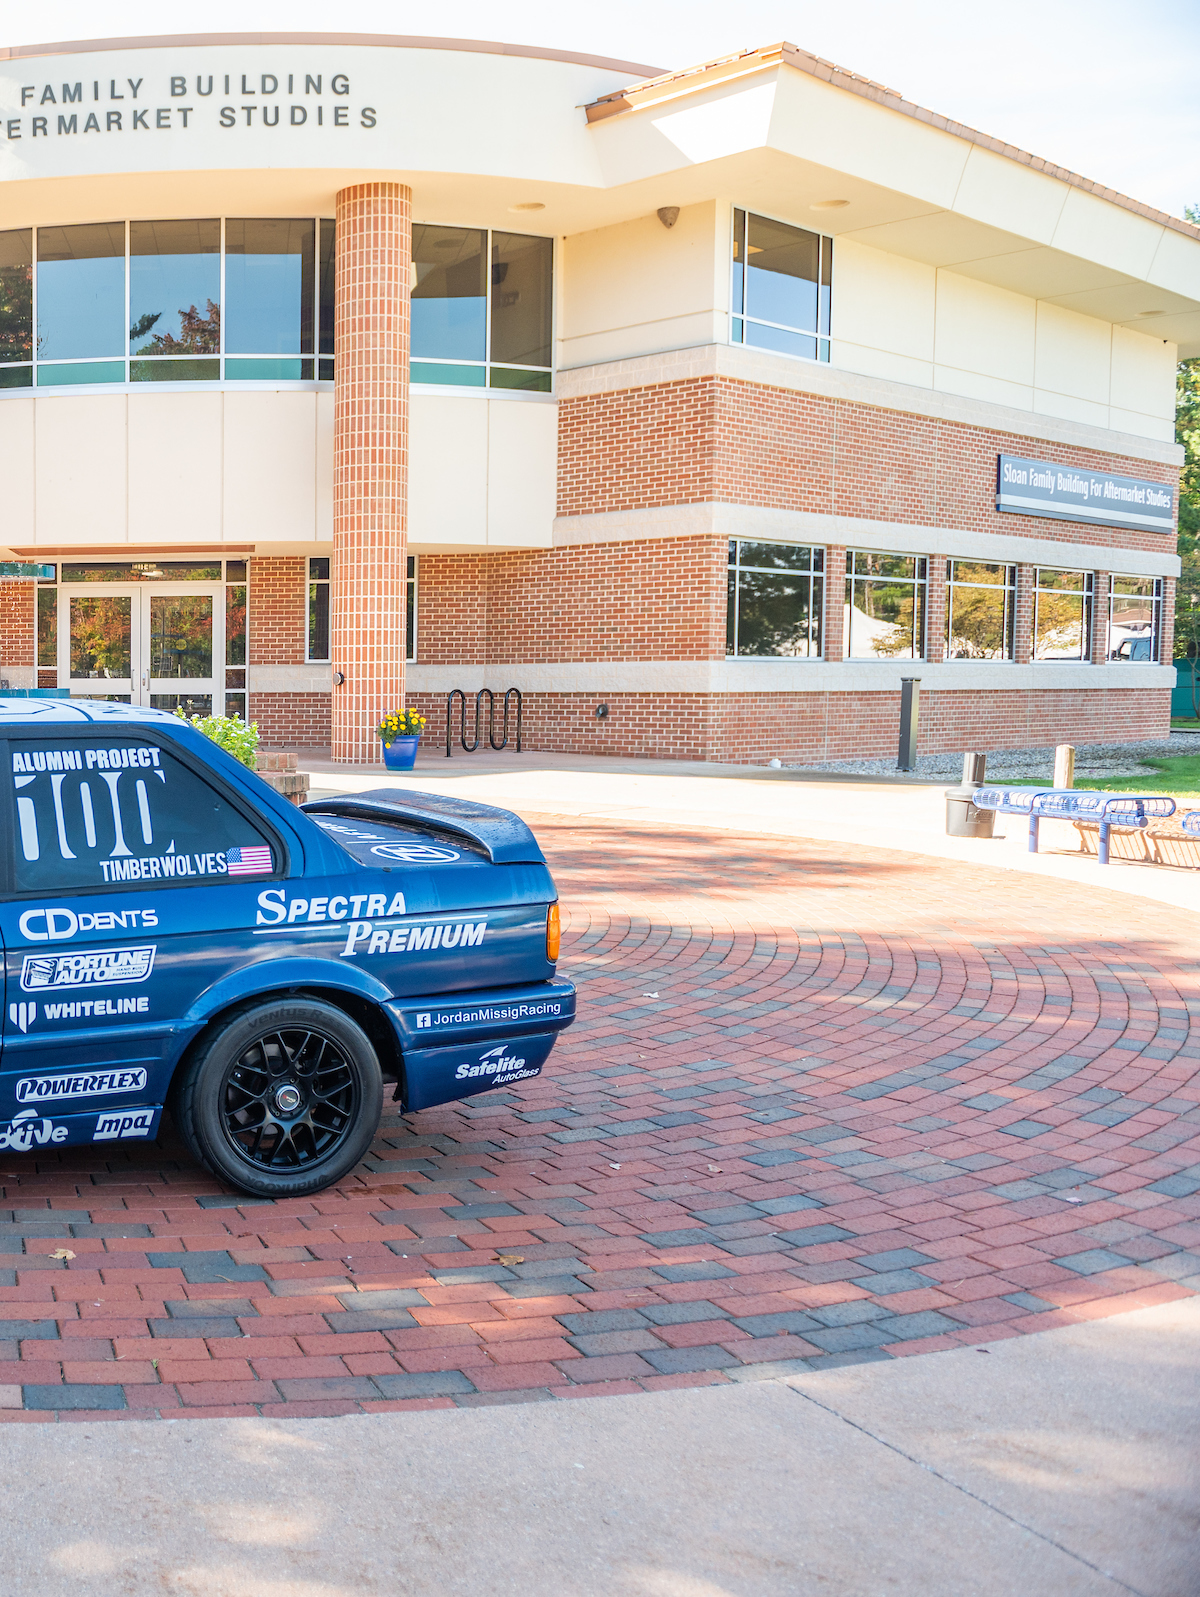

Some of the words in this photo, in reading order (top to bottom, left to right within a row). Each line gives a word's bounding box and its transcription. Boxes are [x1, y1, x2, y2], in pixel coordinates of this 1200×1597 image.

[21, 78, 144, 107] FAMILY
[170, 74, 352, 97] BUILDING
[219, 105, 378, 129] STUDIES
[1004, 464, 1027, 485] Sloan
[1029, 468, 1056, 494] Family
[1057, 472, 1089, 500] Building
[1090, 479, 1102, 497] For
[1104, 481, 1145, 504] Aftermarket
[1146, 489, 1171, 508] Studies
[13, 751, 82, 772] ALUMNI
[85, 747, 160, 769] PROJECT
[100, 852, 228, 882] TIMBERWOLVES
[256, 889, 406, 925] SPECTRA
[339, 921, 487, 957] PREMIUM
[58, 950, 151, 971] FORTUNE
[55, 968, 110, 985] AUTO
[44, 997, 149, 1019] WHITELINE
[434, 1002, 561, 1025] JordanMissigRacing
[455, 1054, 526, 1080] Safelite
[492, 1067, 540, 1085] AutoGlass
[18, 1069, 144, 1100] POWERFLEX
[100, 1112, 150, 1138] mpa
